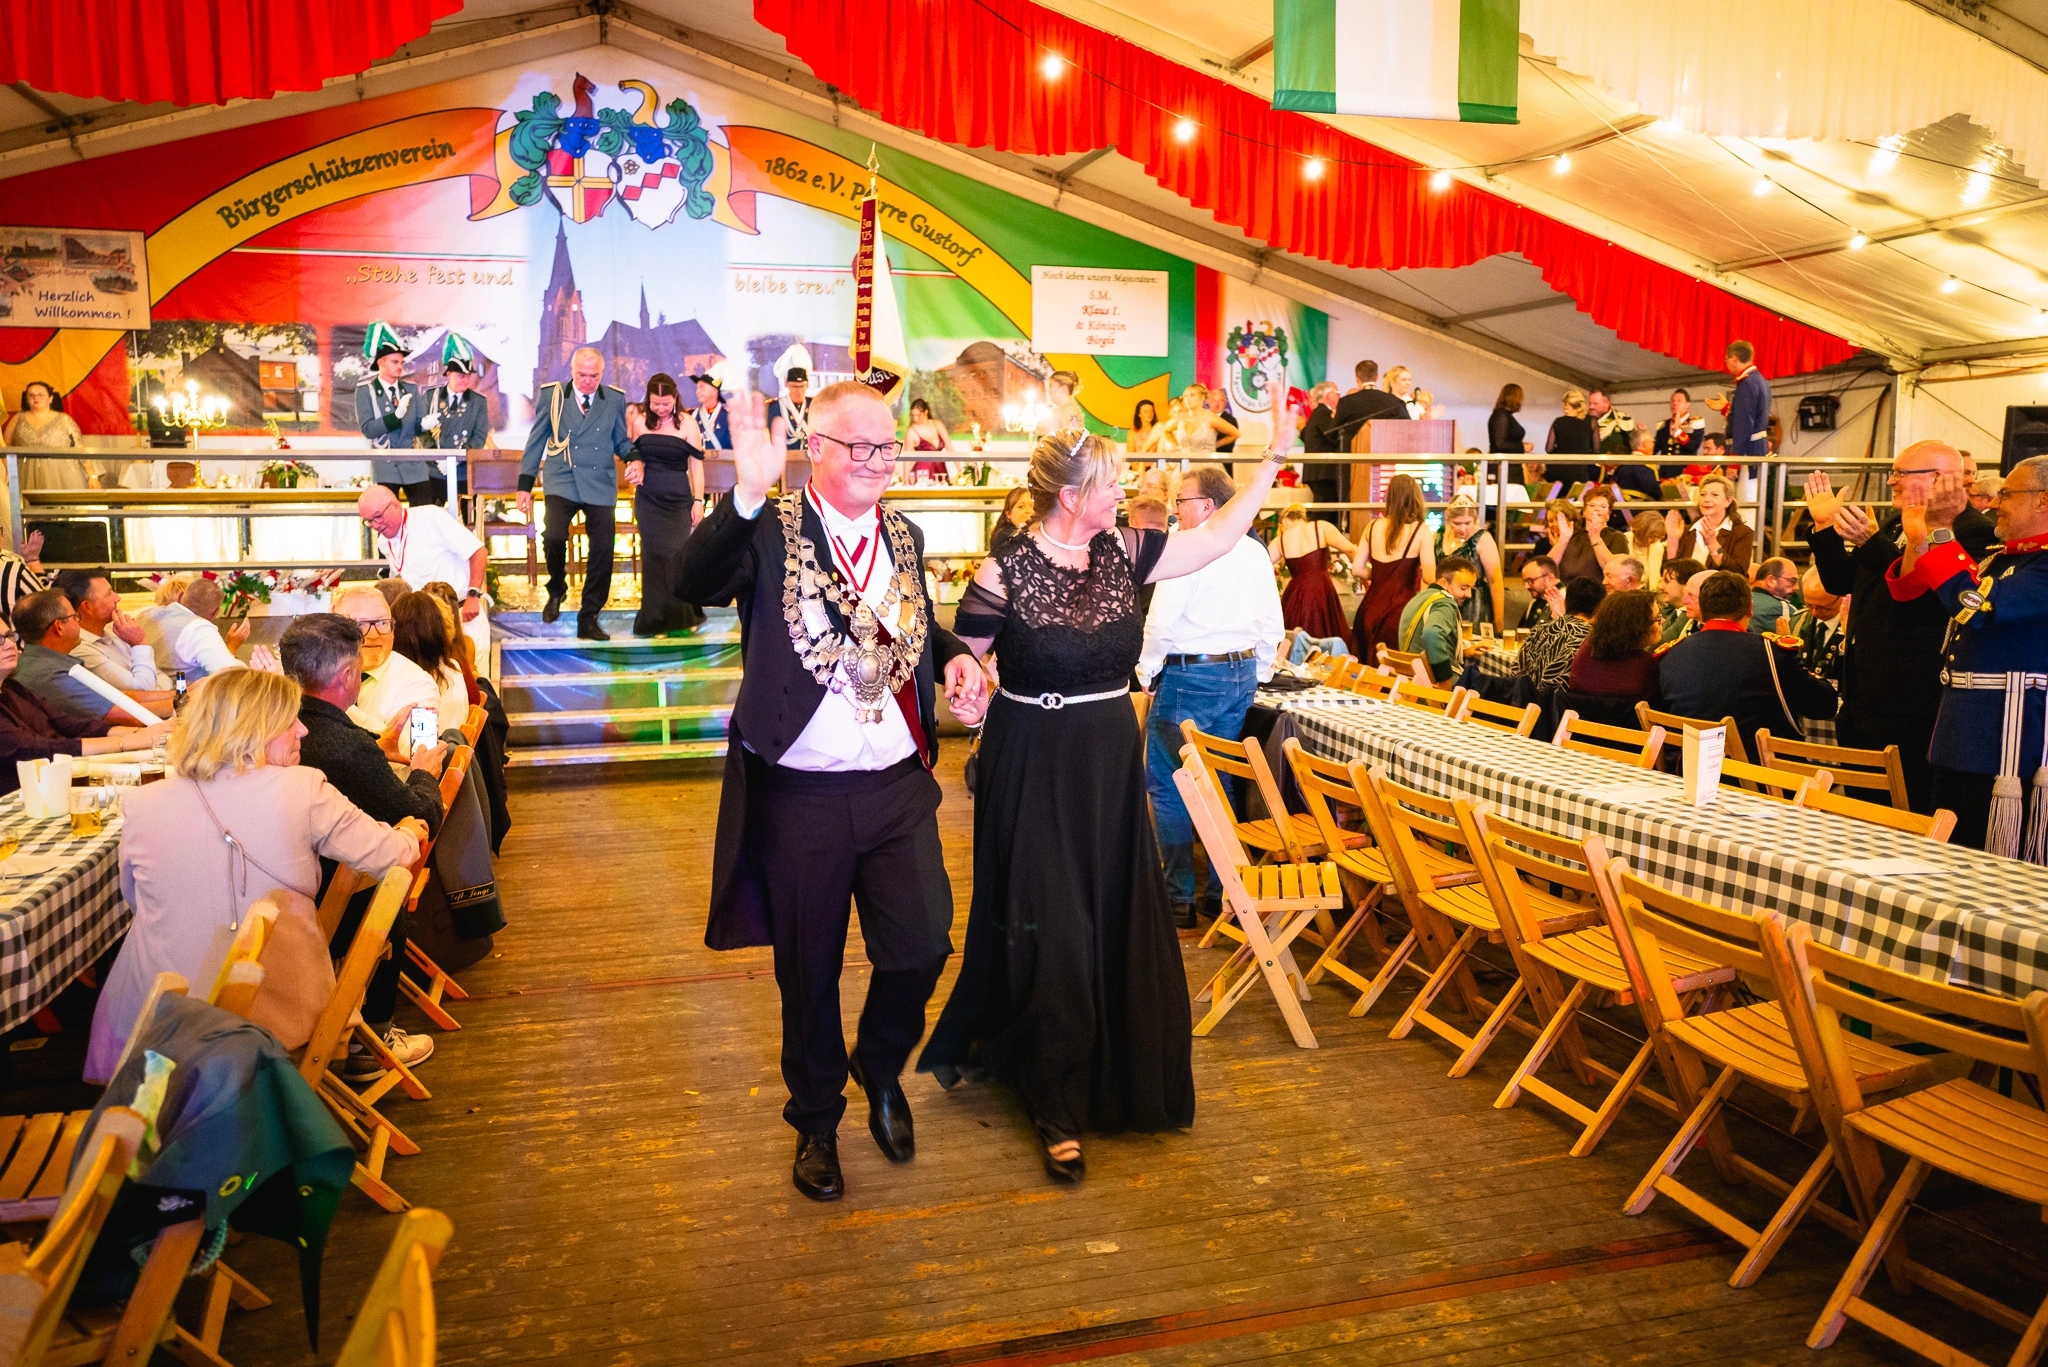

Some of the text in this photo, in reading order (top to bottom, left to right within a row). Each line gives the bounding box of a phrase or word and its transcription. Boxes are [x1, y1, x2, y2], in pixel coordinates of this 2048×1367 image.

[216, 138, 457, 229] Bürgerschützenverein
[765, 157, 809, 184] 1862
[910, 213, 983, 268] Gustorf
[428, 263, 466, 285] fest
[472, 267, 513, 286] und
[734, 272, 788, 294] bleibe
[38, 290, 95, 303] Herzlich
[34, 307, 122, 320] Willkommen
[1081, 304, 1110, 316] Klaus
[1088, 320, 1127, 335] Königin
[1086, 335, 1116, 348] Birgit
